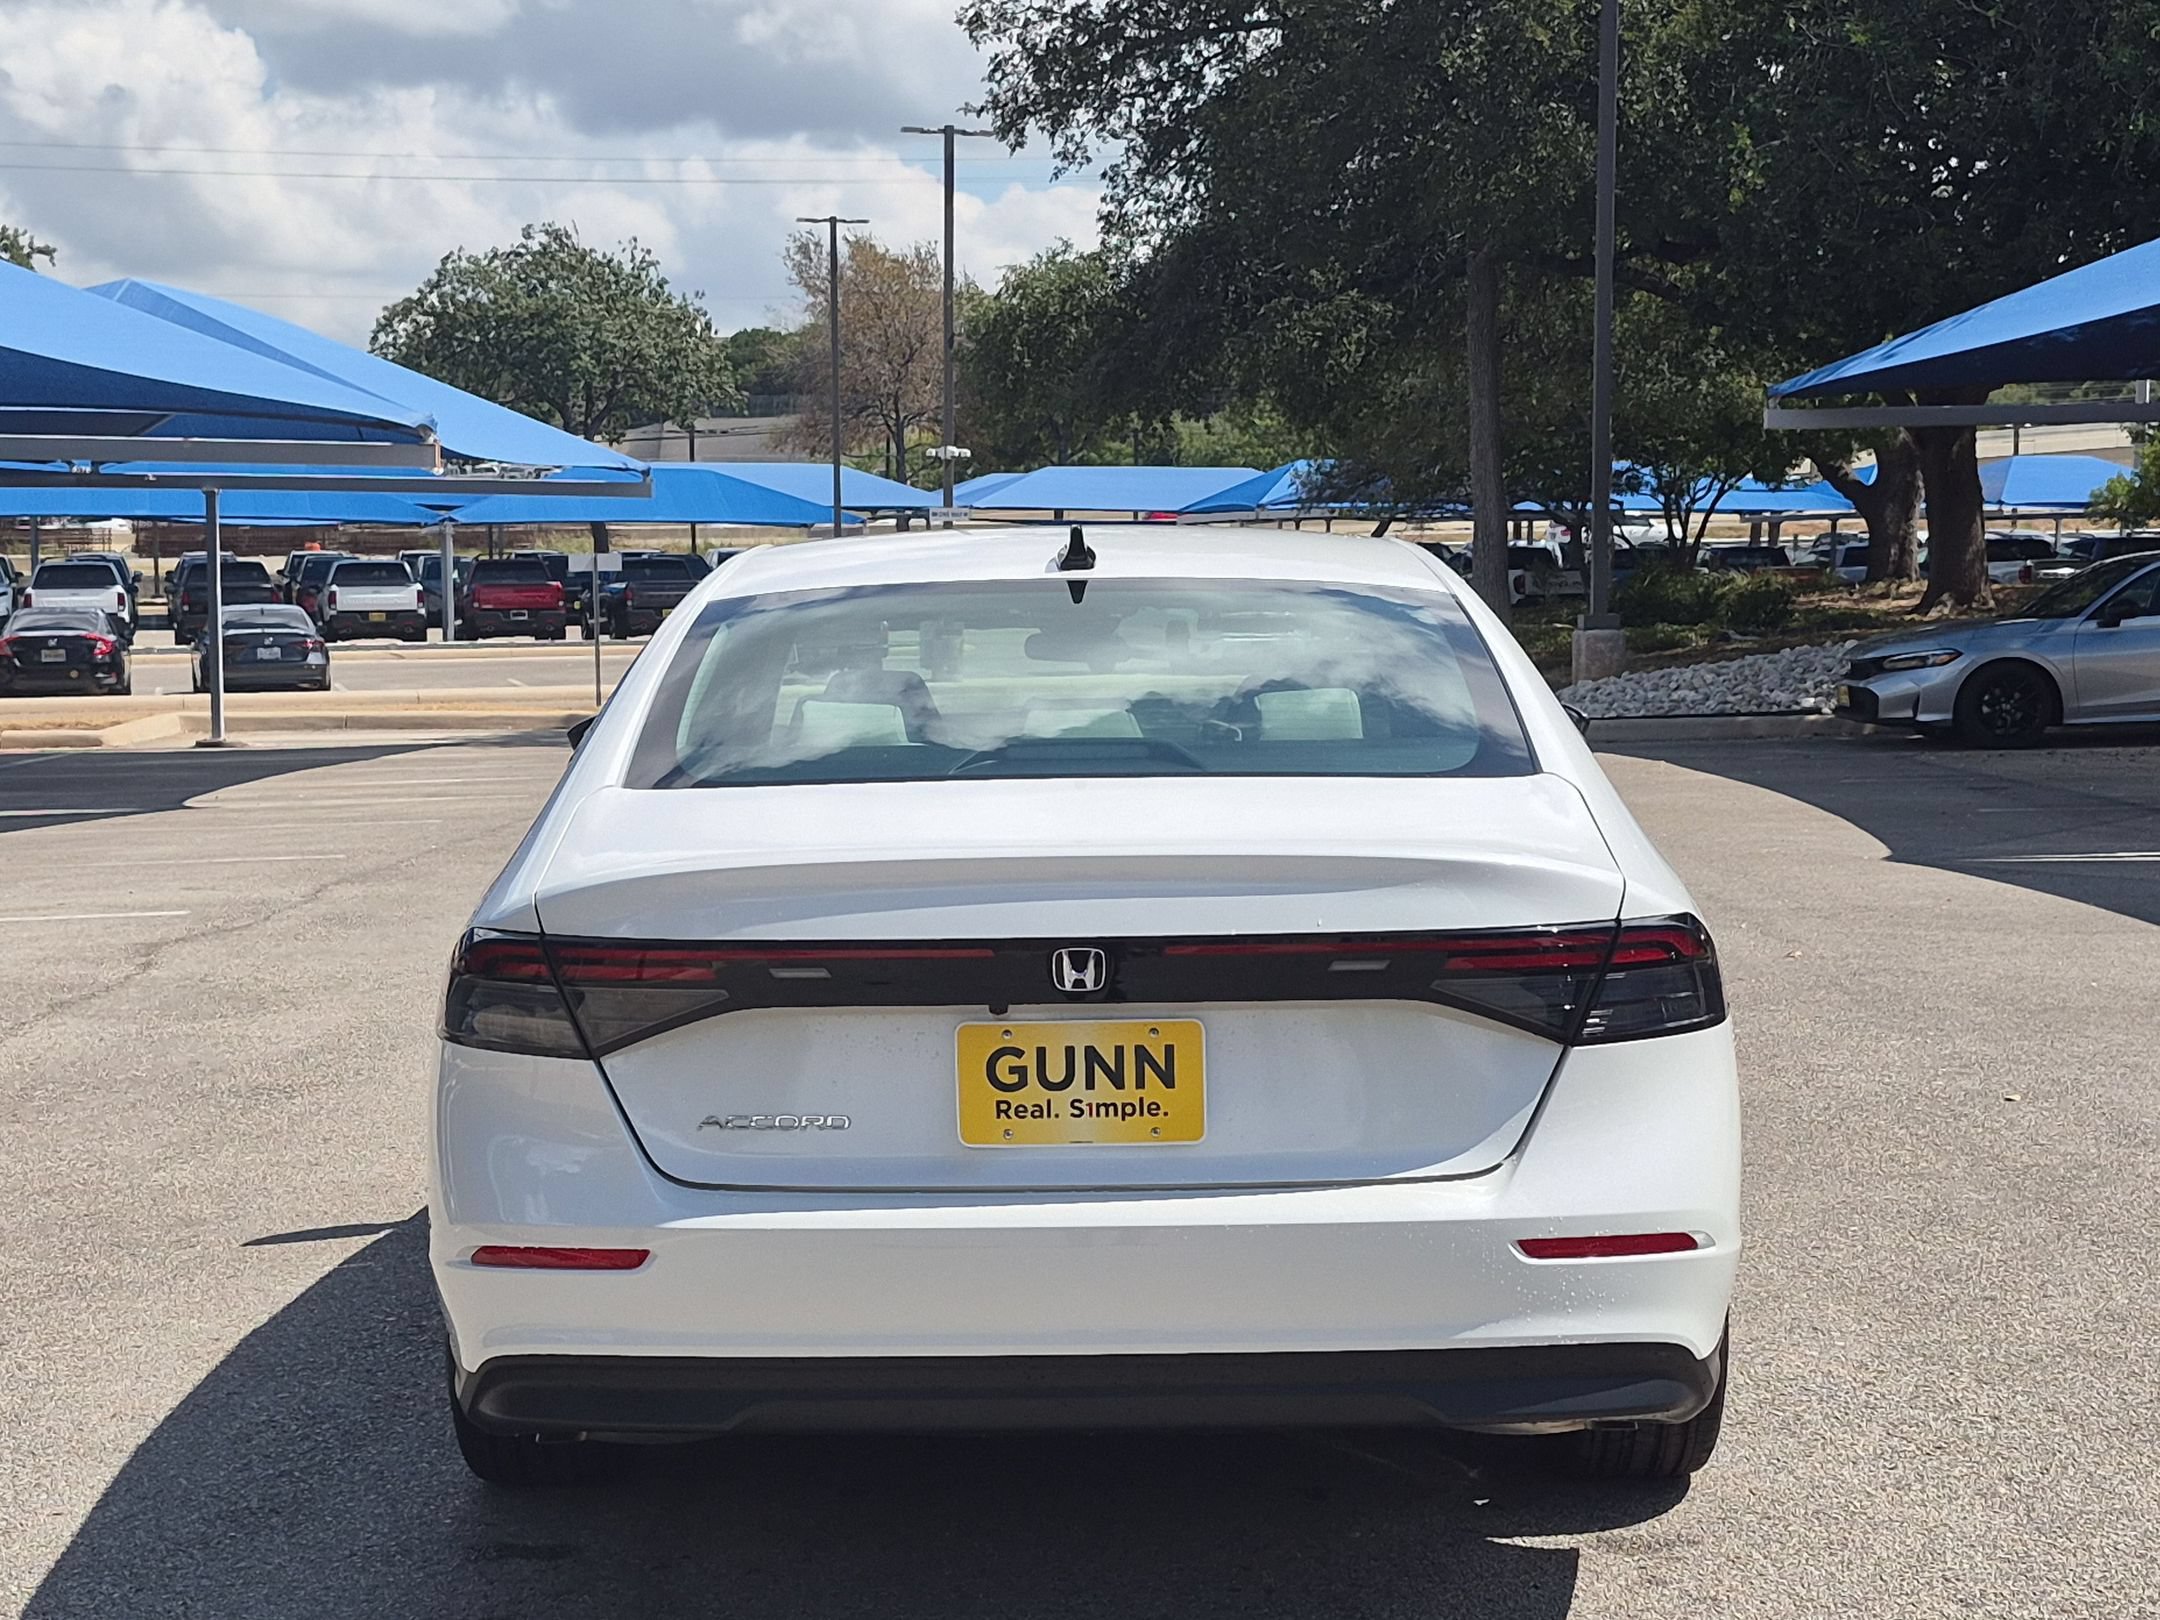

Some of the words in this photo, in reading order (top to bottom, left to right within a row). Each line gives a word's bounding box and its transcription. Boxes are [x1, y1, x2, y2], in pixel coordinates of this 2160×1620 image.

[985, 1043, 1176, 1093] GUNN
[995, 1098, 1060, 1120] Real.
[696, 1114, 852, 1131] ACCORD
